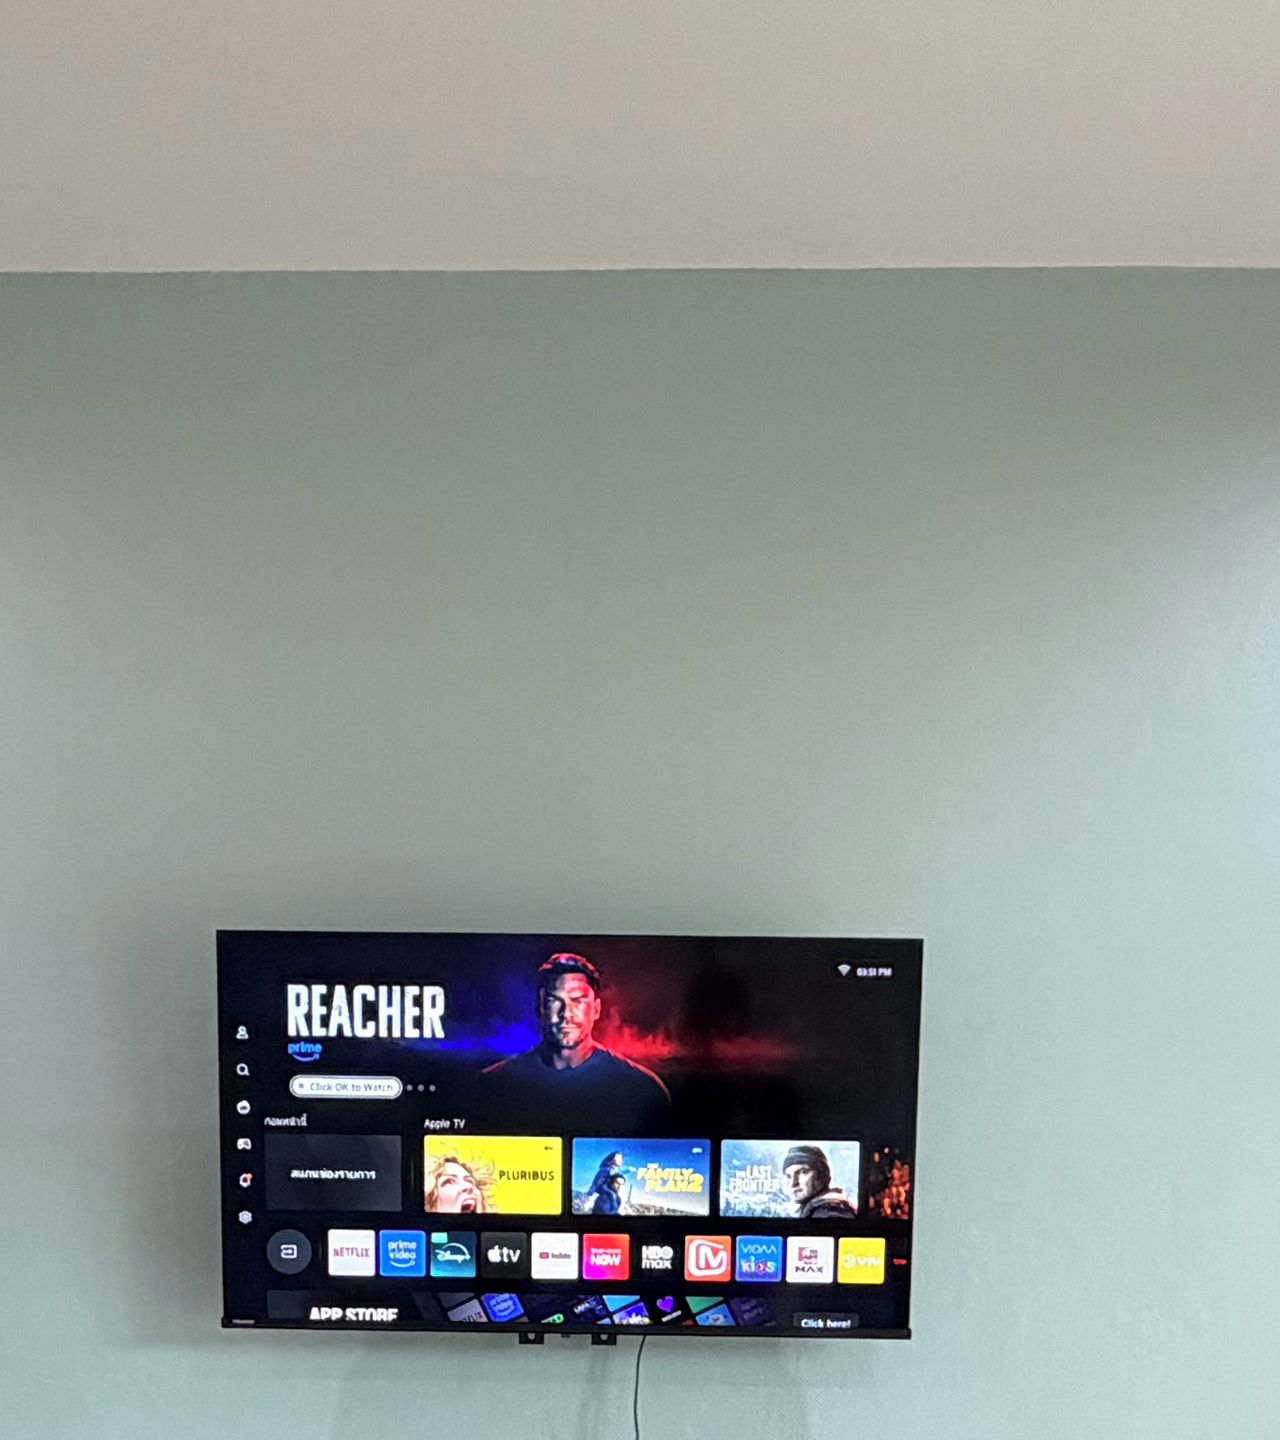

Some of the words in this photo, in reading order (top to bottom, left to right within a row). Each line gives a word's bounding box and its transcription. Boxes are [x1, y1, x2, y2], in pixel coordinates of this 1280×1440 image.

[878, 967, 892, 977] PM
[287, 984, 446, 1039] REACHER
[288, 1042, 323, 1055] prime
[335, 1083, 349, 1092] OK
[351, 1084, 361, 1092] to
[424, 1119, 451, 1130] Apple
[453, 1119, 466, 1130] TV
[499, 1169, 555, 1181] PLURIBUS
[686, 1173, 704, 1193] 2
[333, 1246, 370, 1258] NETFLIX
[501, 1246, 521, 1263] tv
[641, 1245, 674, 1259] HBO
[590, 1254, 622, 1267] NOW
[794, 1265, 824, 1274] MAX
[309, 1307, 343, 1321] APP
